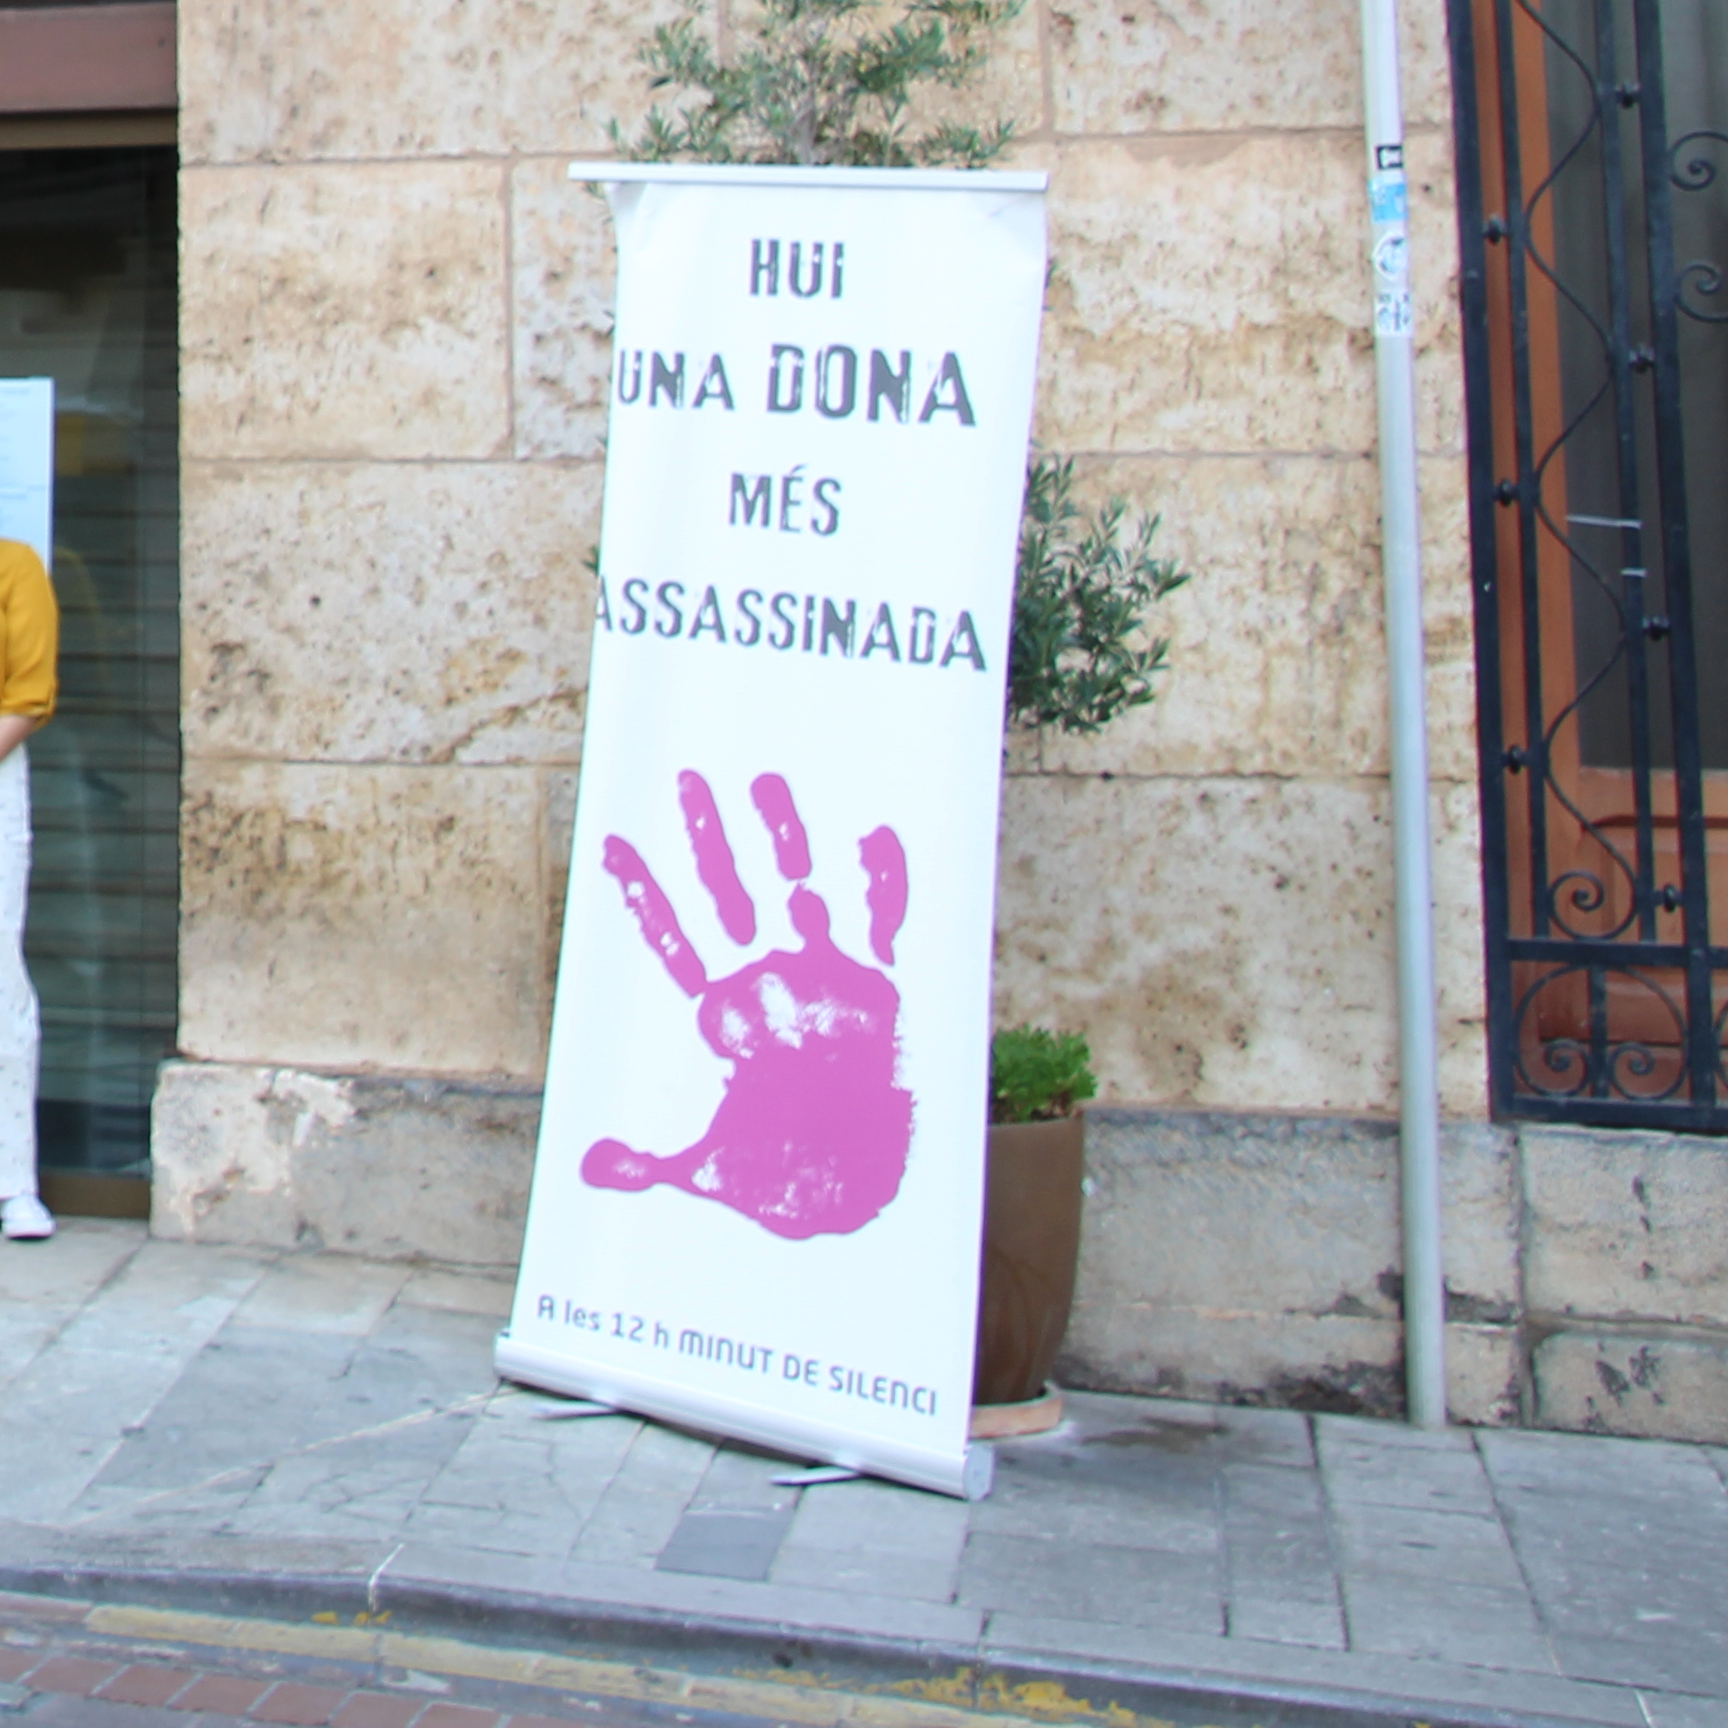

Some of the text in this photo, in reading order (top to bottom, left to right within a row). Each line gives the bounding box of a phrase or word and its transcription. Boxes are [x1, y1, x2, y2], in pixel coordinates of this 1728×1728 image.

[748, 238, 846, 299] HUI
[617, 342, 977, 428] UNA DONA
[728, 464, 843, 537] MÉS
[594, 575, 987, 673] ASSASSINADA
[537, 1293, 555, 1321] A
[564, 1298, 602, 1332] les
[611, 1312, 645, 1344] 12
[653, 1322, 670, 1350] h
[782, 1352, 820, 1387] DE
[828, 1364, 938, 1417] SILENCI
